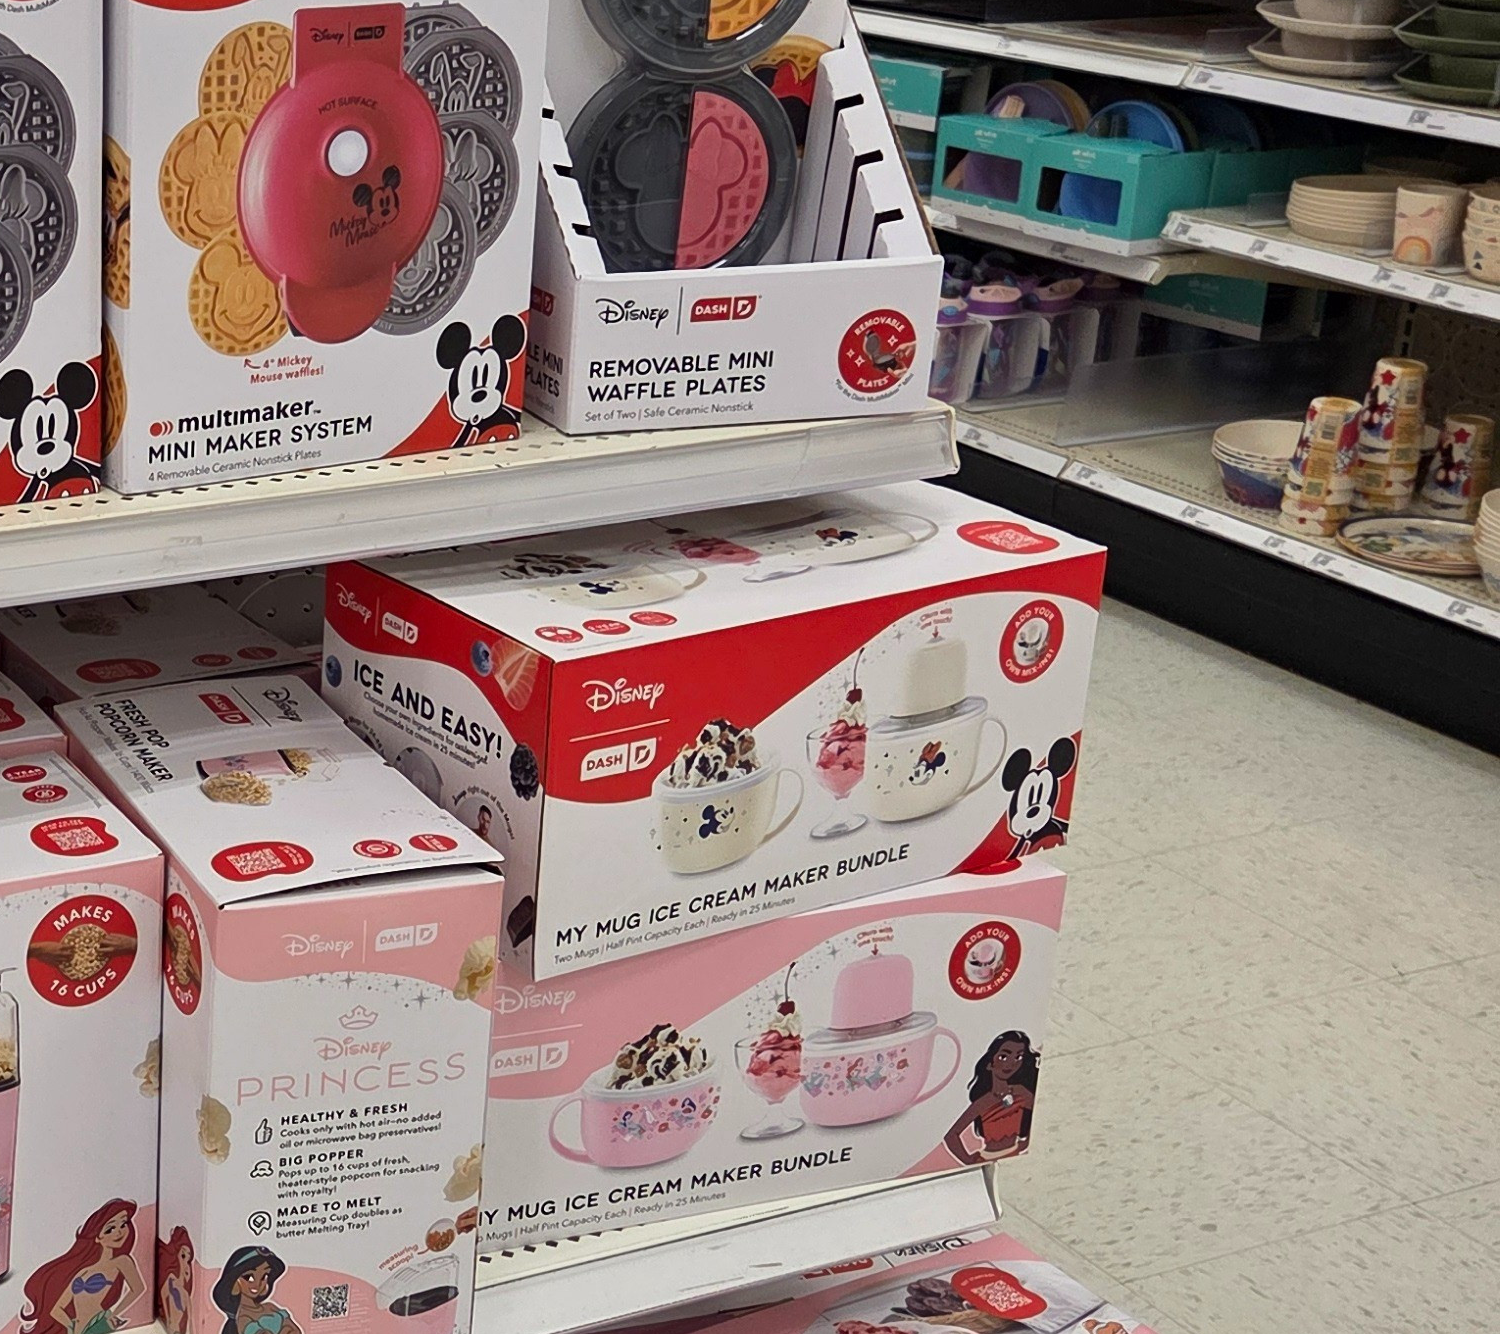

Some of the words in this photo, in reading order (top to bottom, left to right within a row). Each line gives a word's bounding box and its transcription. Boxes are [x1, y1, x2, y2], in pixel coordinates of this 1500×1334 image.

[596, 298, 669, 329] Disney
[695, 304, 727, 316] DASH
[854, 317, 905, 336] REMOVABLE
[589, 354, 721, 379] REMOVABLE
[729, 351, 774, 368] MINI
[588, 380, 678, 402] WAFFLE
[686, 375, 766, 397] PLATES
[585, 411, 601, 422] Set
[603, 410, 614, 420] of
[616, 409, 636, 419] Two
[644, 406, 664, 417] Safe
[667, 403, 709, 416] Ceramic
[711, 401, 754, 413] Nonstick
[148, 442, 196, 464] MINI
[206, 431, 281, 455] MAKER
[291, 415, 372, 443] SYSTEM
[354, 659, 384, 696] ICE
[391, 683, 434, 720] AND
[441, 708, 502, 759] EASY!
[583, 677, 665, 714] Disney
[585, 750, 626, 771] DASH
[556, 927, 586, 948] MY
[595, 912, 640, 938] MUG
[648, 901, 680, 923] ICE
[688, 883, 756, 915] CREAM
[764, 865, 828, 895] MAKER
[836, 847, 908, 877] BUNDLE
[52, 906, 113, 931] MAKES
[50, 979, 67, 996] 16
[73, 967, 118, 998] CUPS
[494, 985, 576, 1014] Disney
[314, 1035, 392, 1060] Disney
[494, 1051, 533, 1069] DASH
[237, 1053, 465, 1106] PRINCESS
[281, 1110, 344, 1126] HEALTHY
[350, 1109, 358, 1118] &
[364, 1103, 408, 1116] FRESH
[279, 1155, 302, 1167] BIG
[309, 1149, 363, 1163] POPPER
[478, 1208, 499, 1226] Y
[508, 1199, 555, 1222] MUG
[564, 1191, 600, 1212] ICE
[609, 1177, 682, 1204] CREAM
[692, 1162, 762, 1189] MAKER
[771, 1147, 852, 1174] BUNDLE
[277, 1204, 318, 1217] MADE
[323, 1201, 341, 1211] TO
[347, 1197, 382, 1208] MELT
